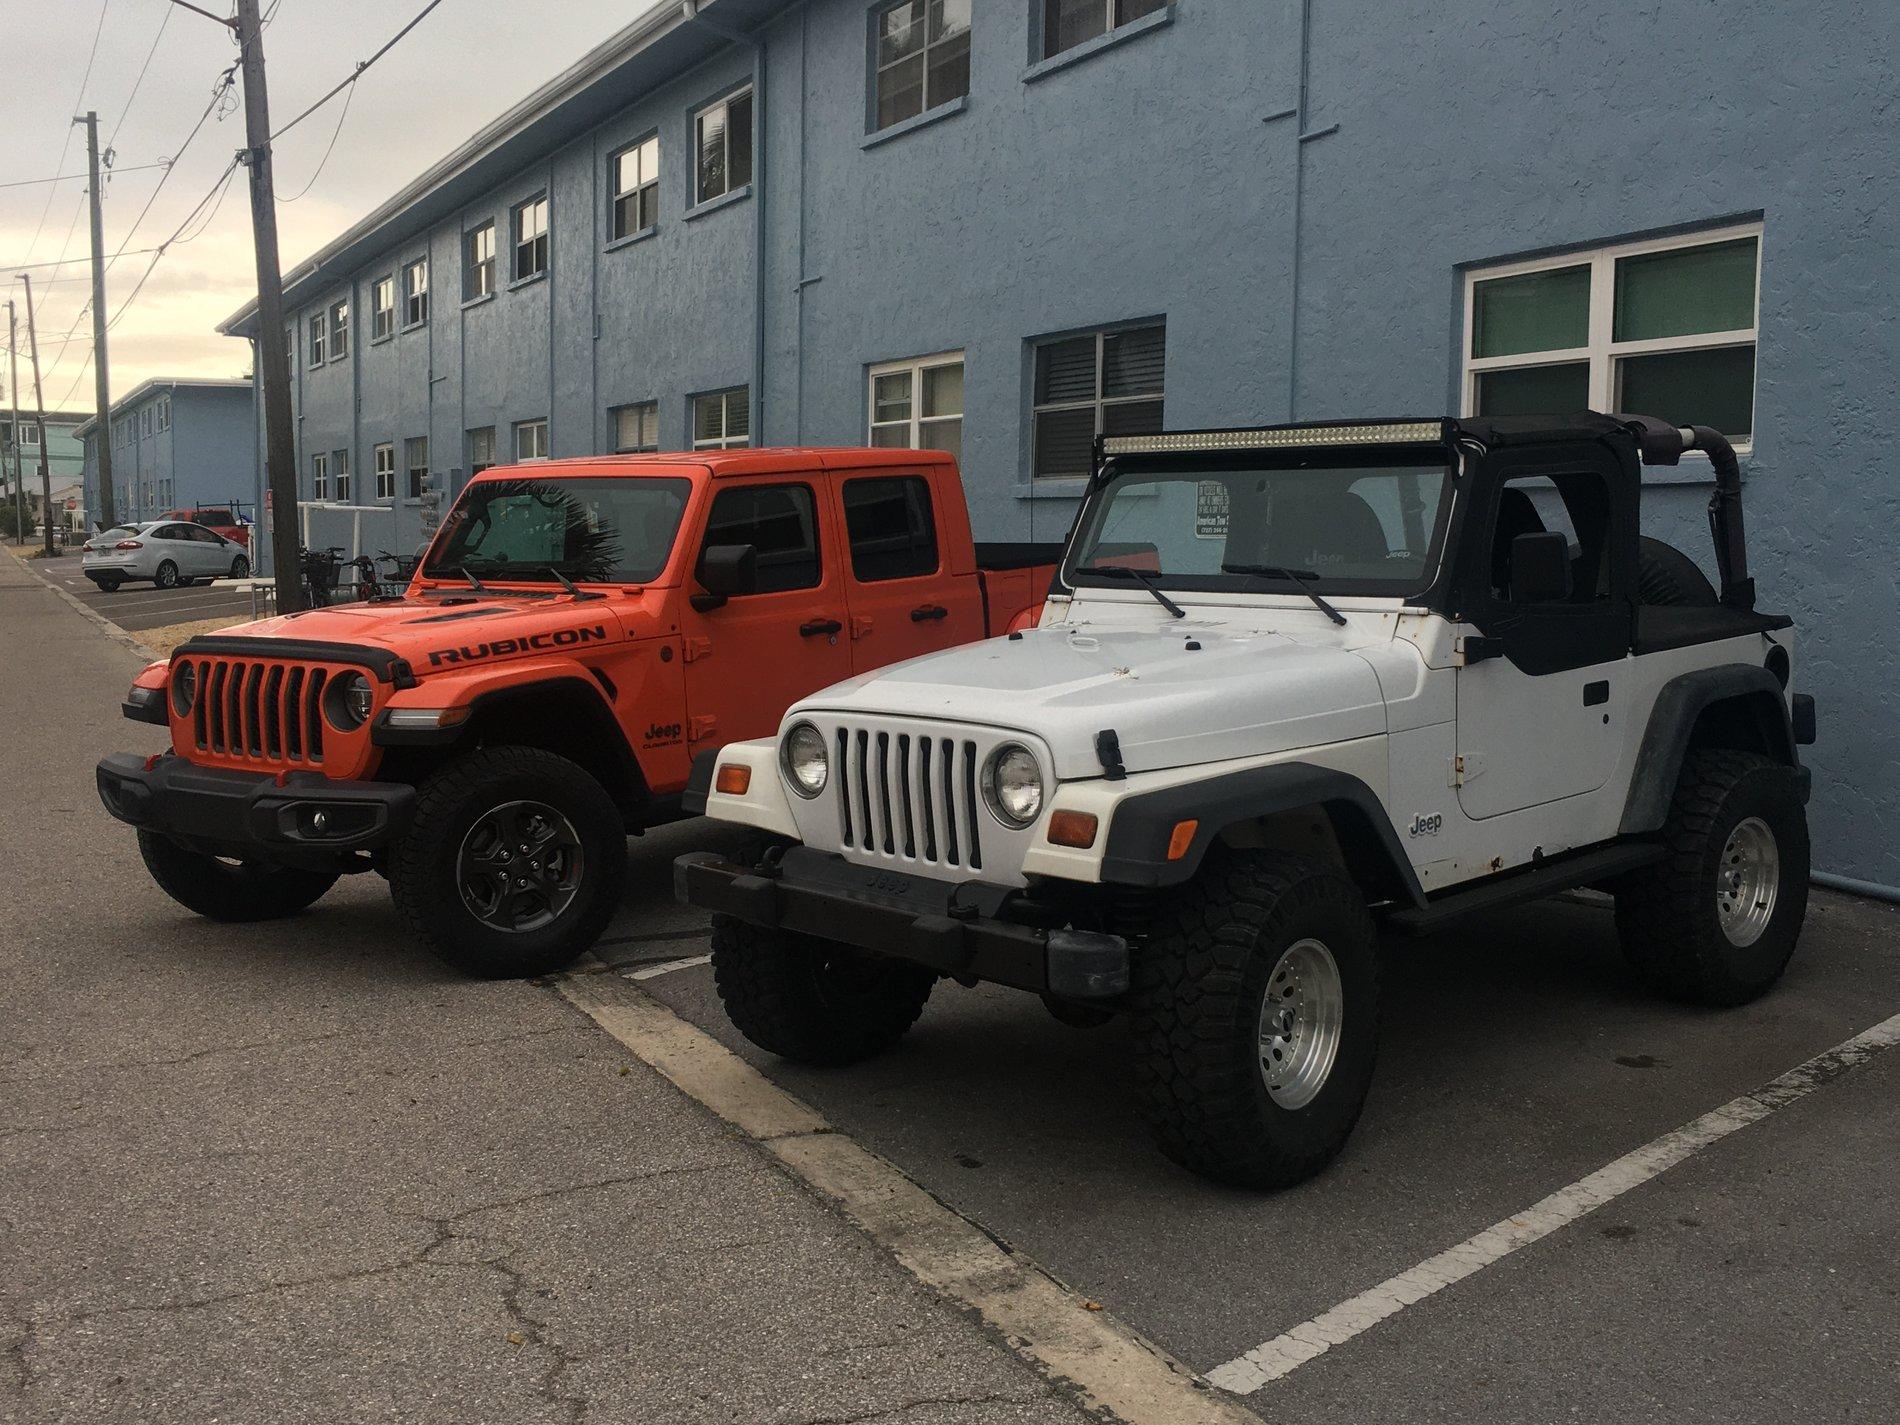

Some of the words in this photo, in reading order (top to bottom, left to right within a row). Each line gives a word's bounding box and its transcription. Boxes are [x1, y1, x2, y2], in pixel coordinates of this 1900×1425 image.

[1385, 550, 1411, 560] Jeep
[428, 625, 606, 666] RUBICON
[644, 723, 682, 740] Jeep
[1408, 812, 1442, 837] Jeep
